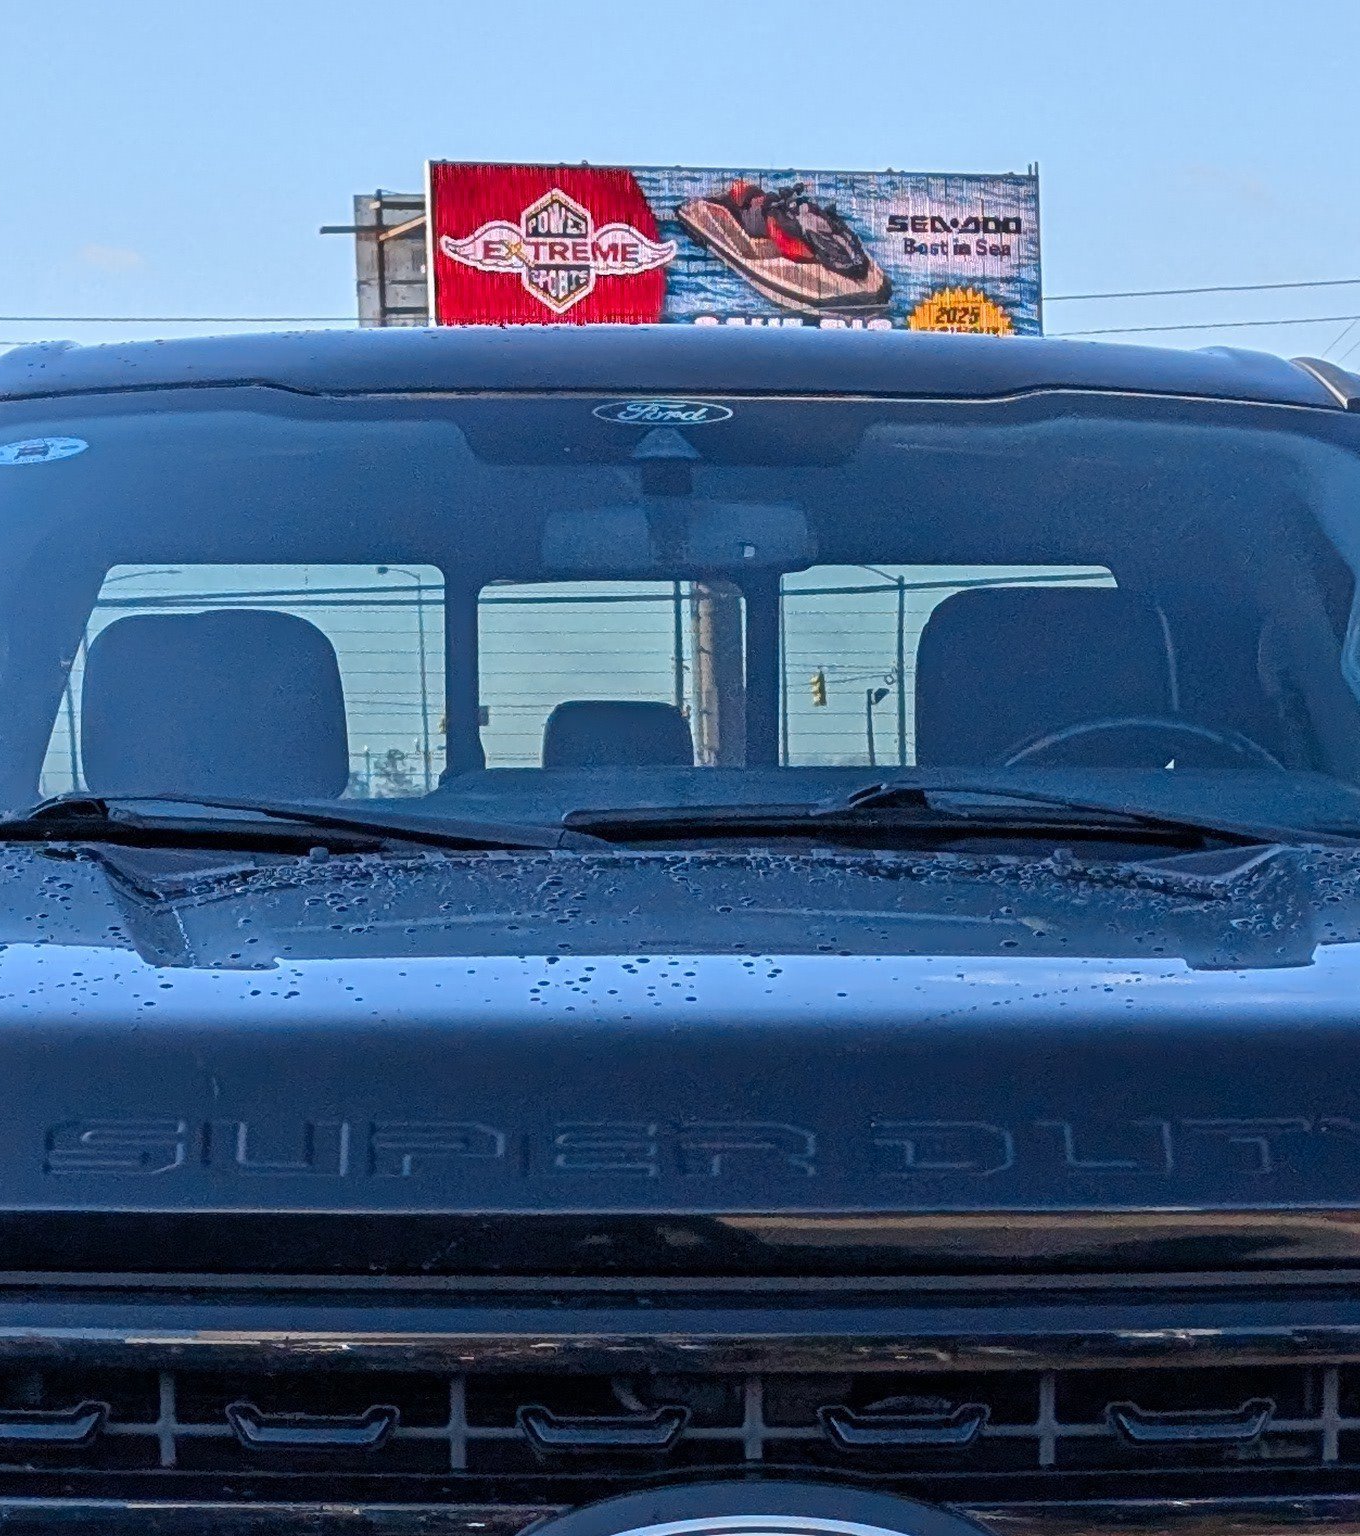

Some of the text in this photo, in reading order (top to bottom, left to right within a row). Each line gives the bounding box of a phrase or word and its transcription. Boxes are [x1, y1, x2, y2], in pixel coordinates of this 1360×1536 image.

[481, 240, 640, 266] EXTREME
[976, 237, 1011, 256] Sea
[936, 306, 980, 324] 2025
[617, 403, 709, 421] Ford
[42, 1120, 817, 1179] SUPER
